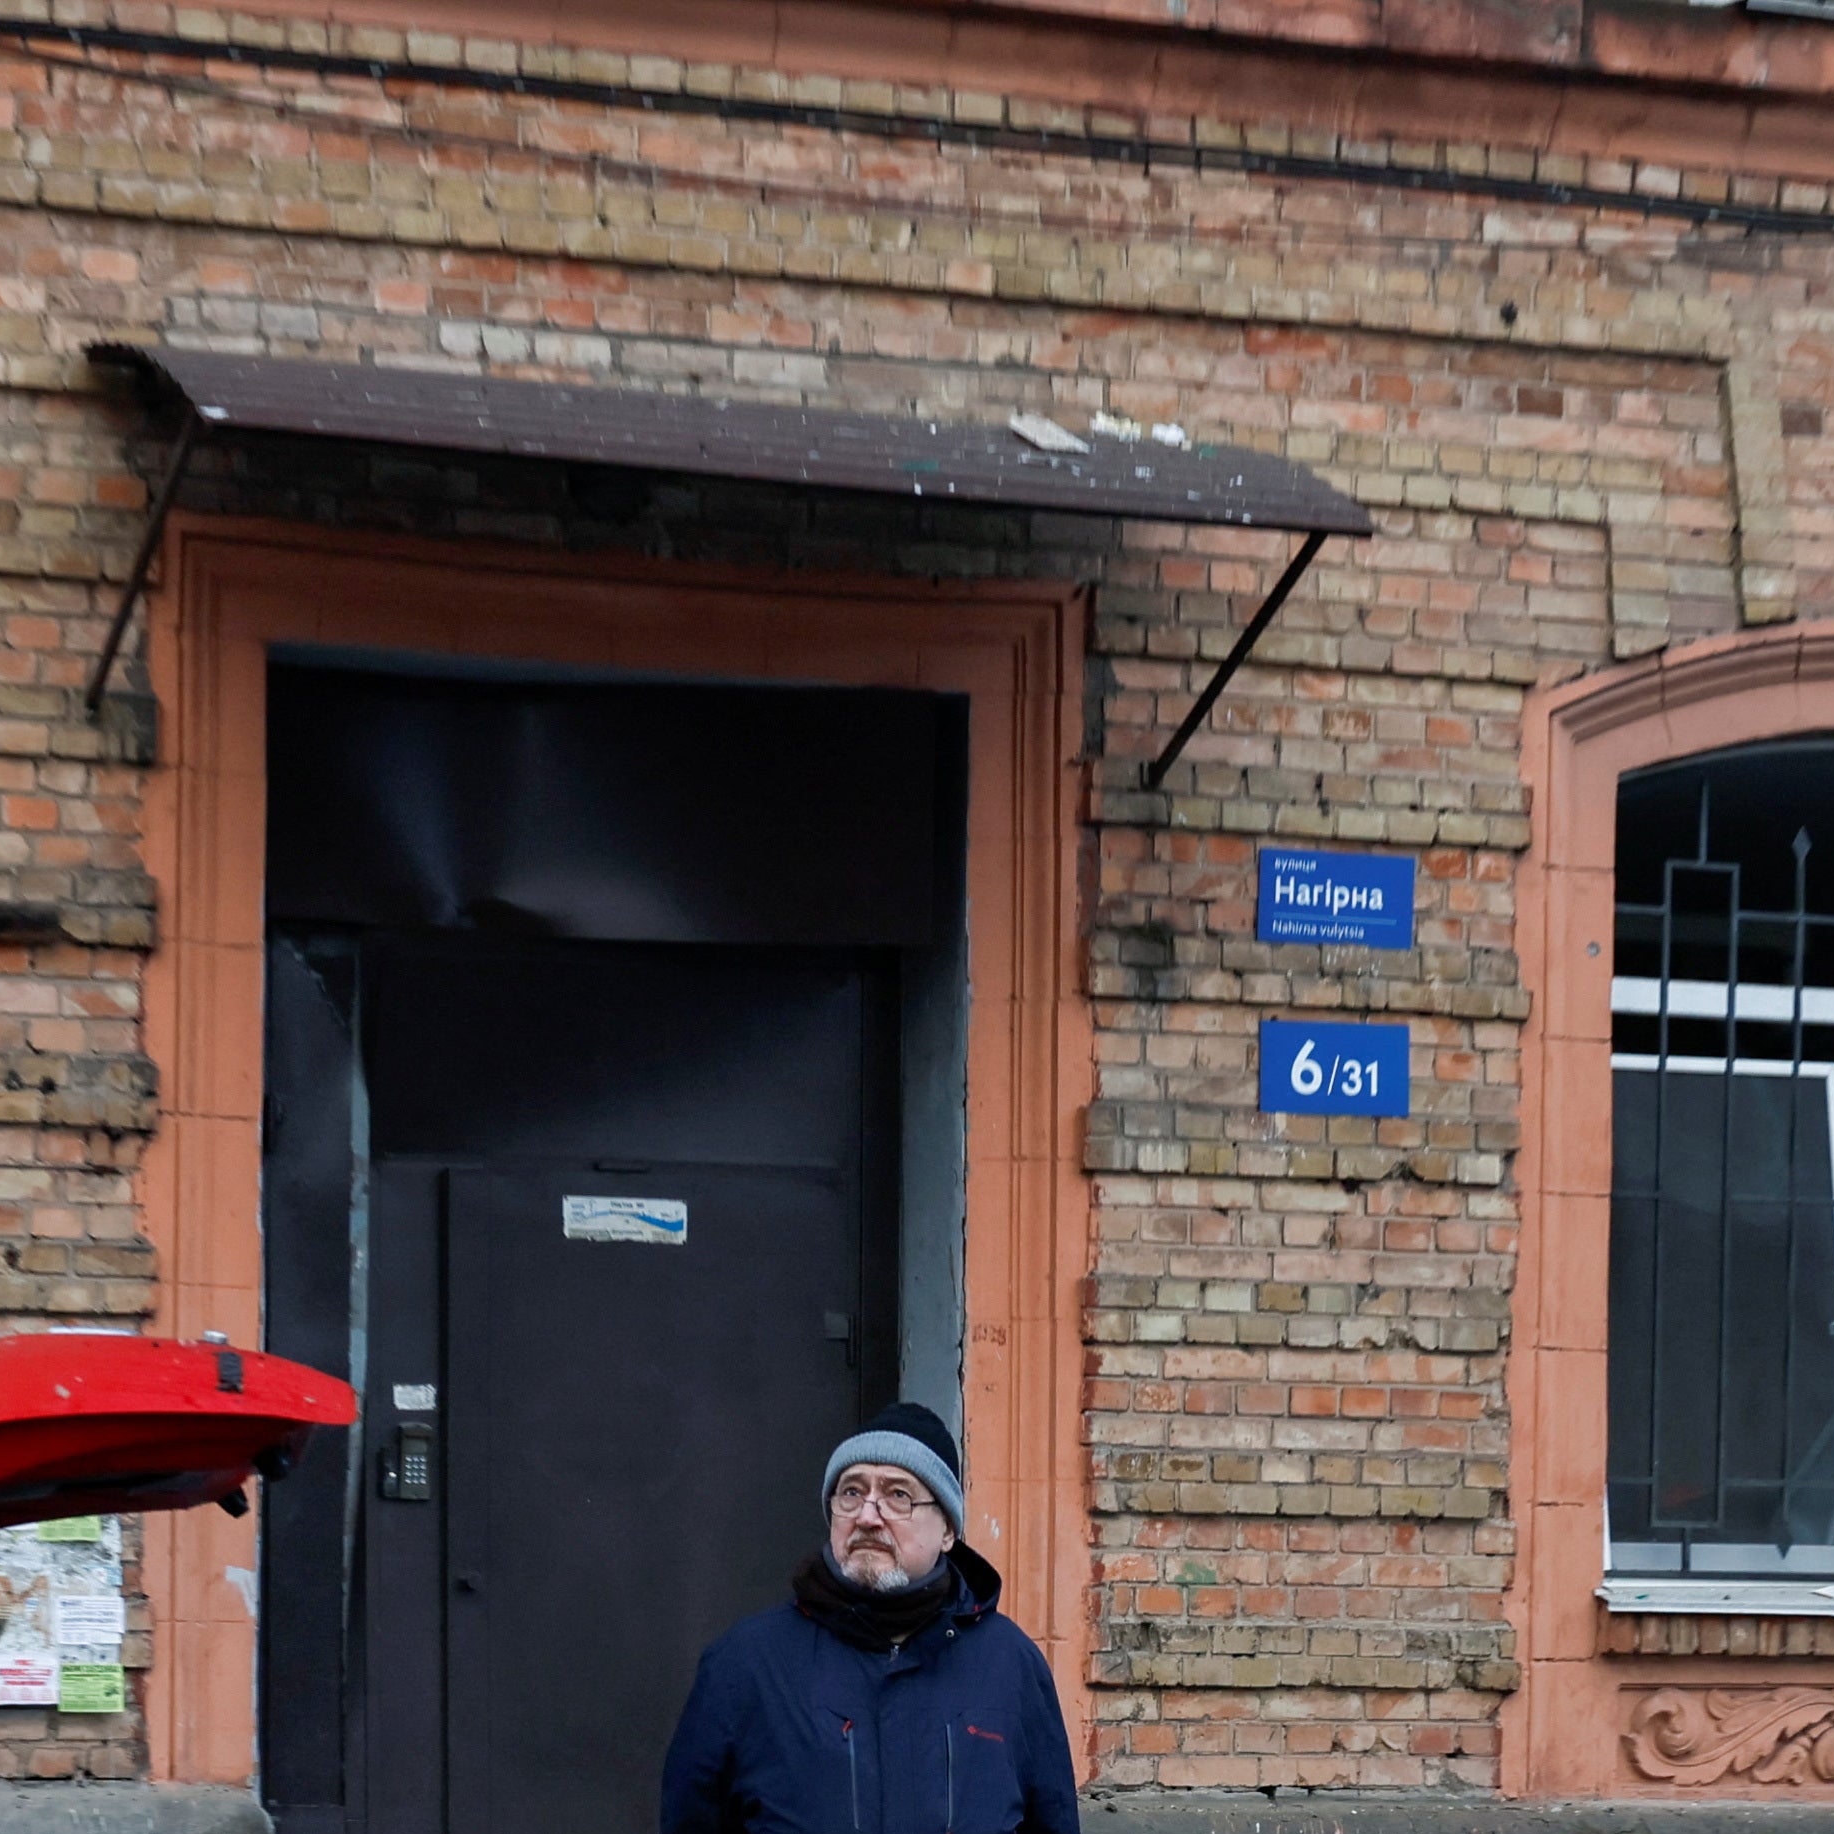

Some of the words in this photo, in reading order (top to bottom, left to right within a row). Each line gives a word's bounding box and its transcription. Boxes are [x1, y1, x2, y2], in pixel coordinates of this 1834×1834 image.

[1274, 857, 1317, 873] вулиця
[1274, 875, 1384, 916] Нагірна
[1272, 919, 1318, 937] Nahirna
[1320, 922, 1365, 940] vulytsia
[1290, 1038, 1379, 1097] 6/31
